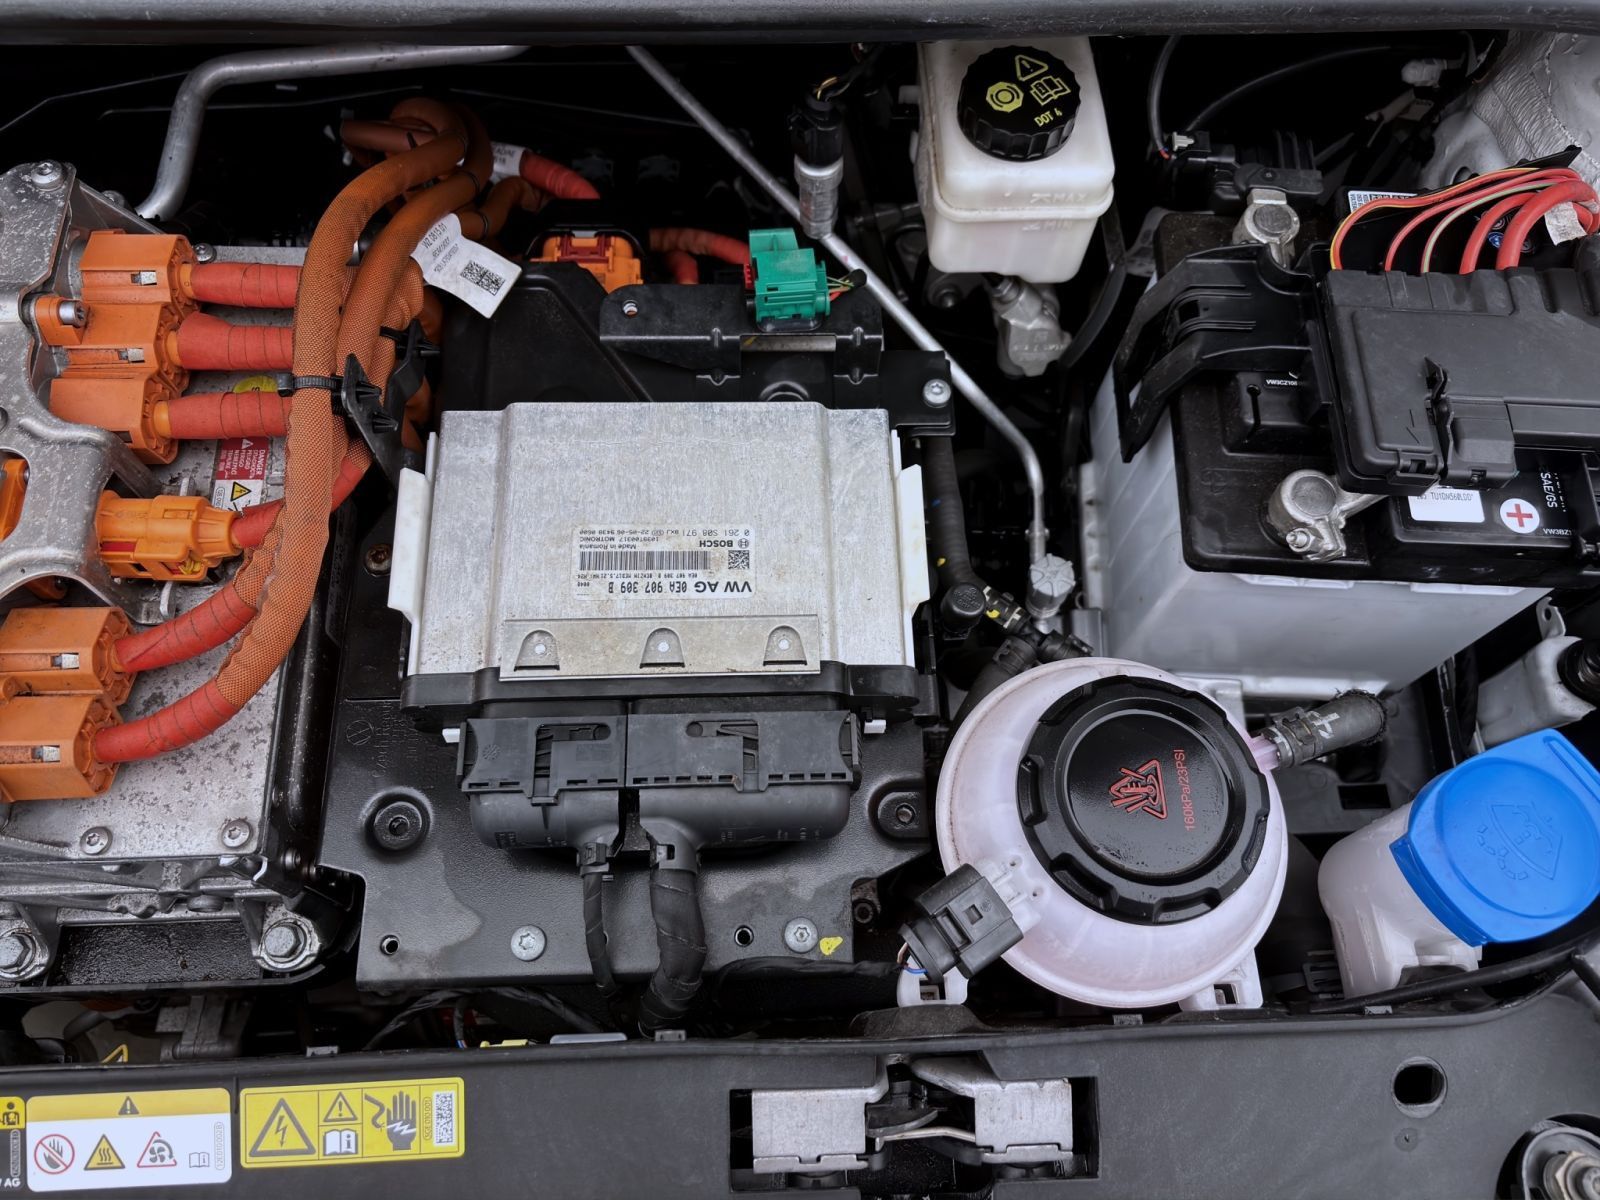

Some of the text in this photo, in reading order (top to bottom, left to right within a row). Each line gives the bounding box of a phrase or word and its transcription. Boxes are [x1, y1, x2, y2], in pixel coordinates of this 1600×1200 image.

[1033, 107, 1063, 127] DOT 4
[256, 449, 266, 475] DANGER
[1540, 472, 1558, 508] SAE/GS
[724, 529, 740, 537] 261
[699, 540, 734, 548] BOSCH
[607, 581, 752, 594] VW AG 0EA 907 309 B
[1173, 749, 1196, 832] 160kPa/23PSI
[4, 1178, 21, 1189] AG
